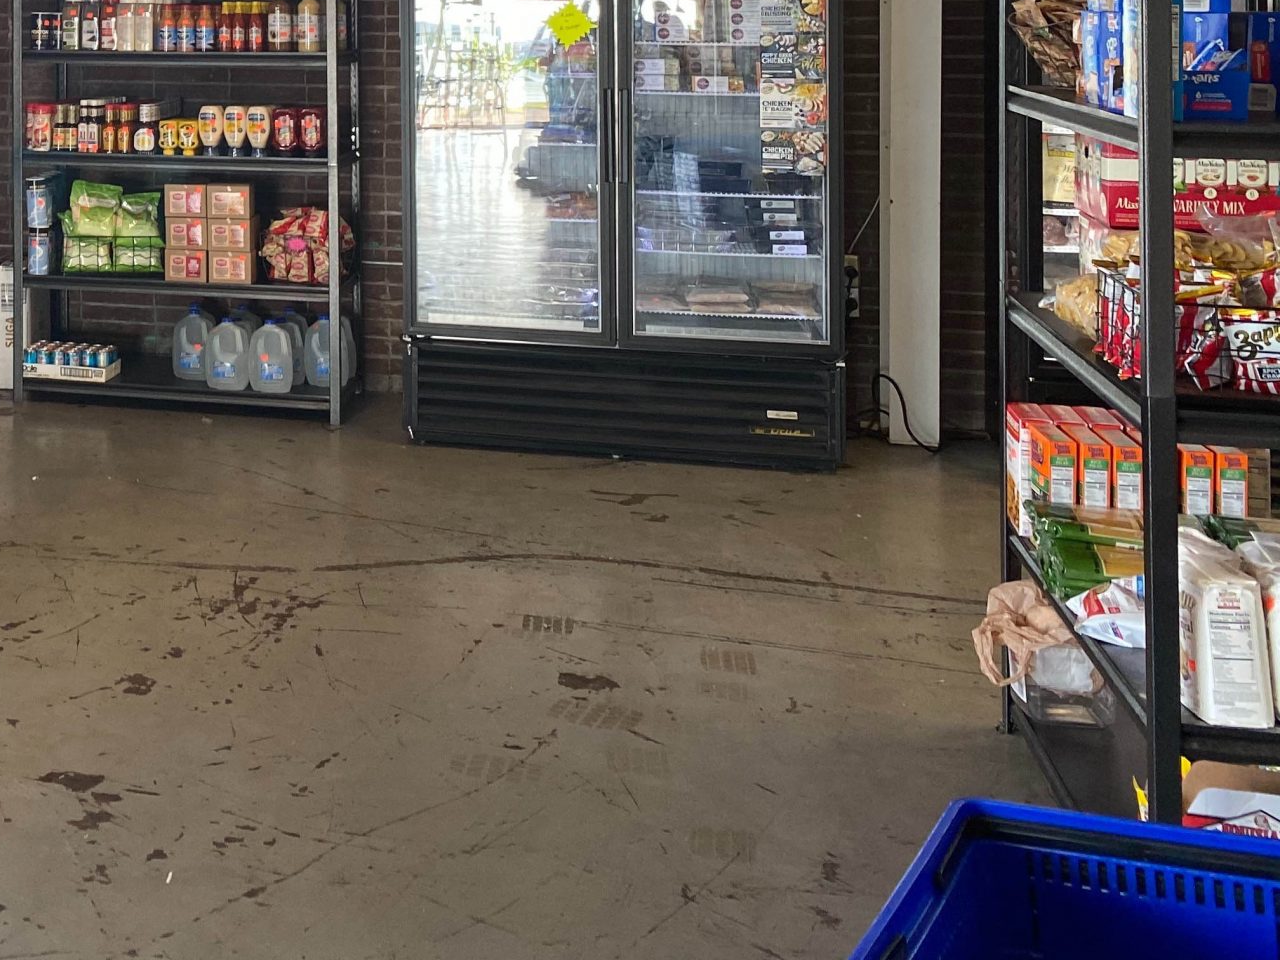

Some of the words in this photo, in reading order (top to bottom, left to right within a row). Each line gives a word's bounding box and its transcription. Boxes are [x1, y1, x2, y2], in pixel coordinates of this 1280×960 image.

[1115, 197, 1139, 209] Miss
[1173, 200, 1220, 214] VARITY
[1222, 201, 1246, 215] MIX
